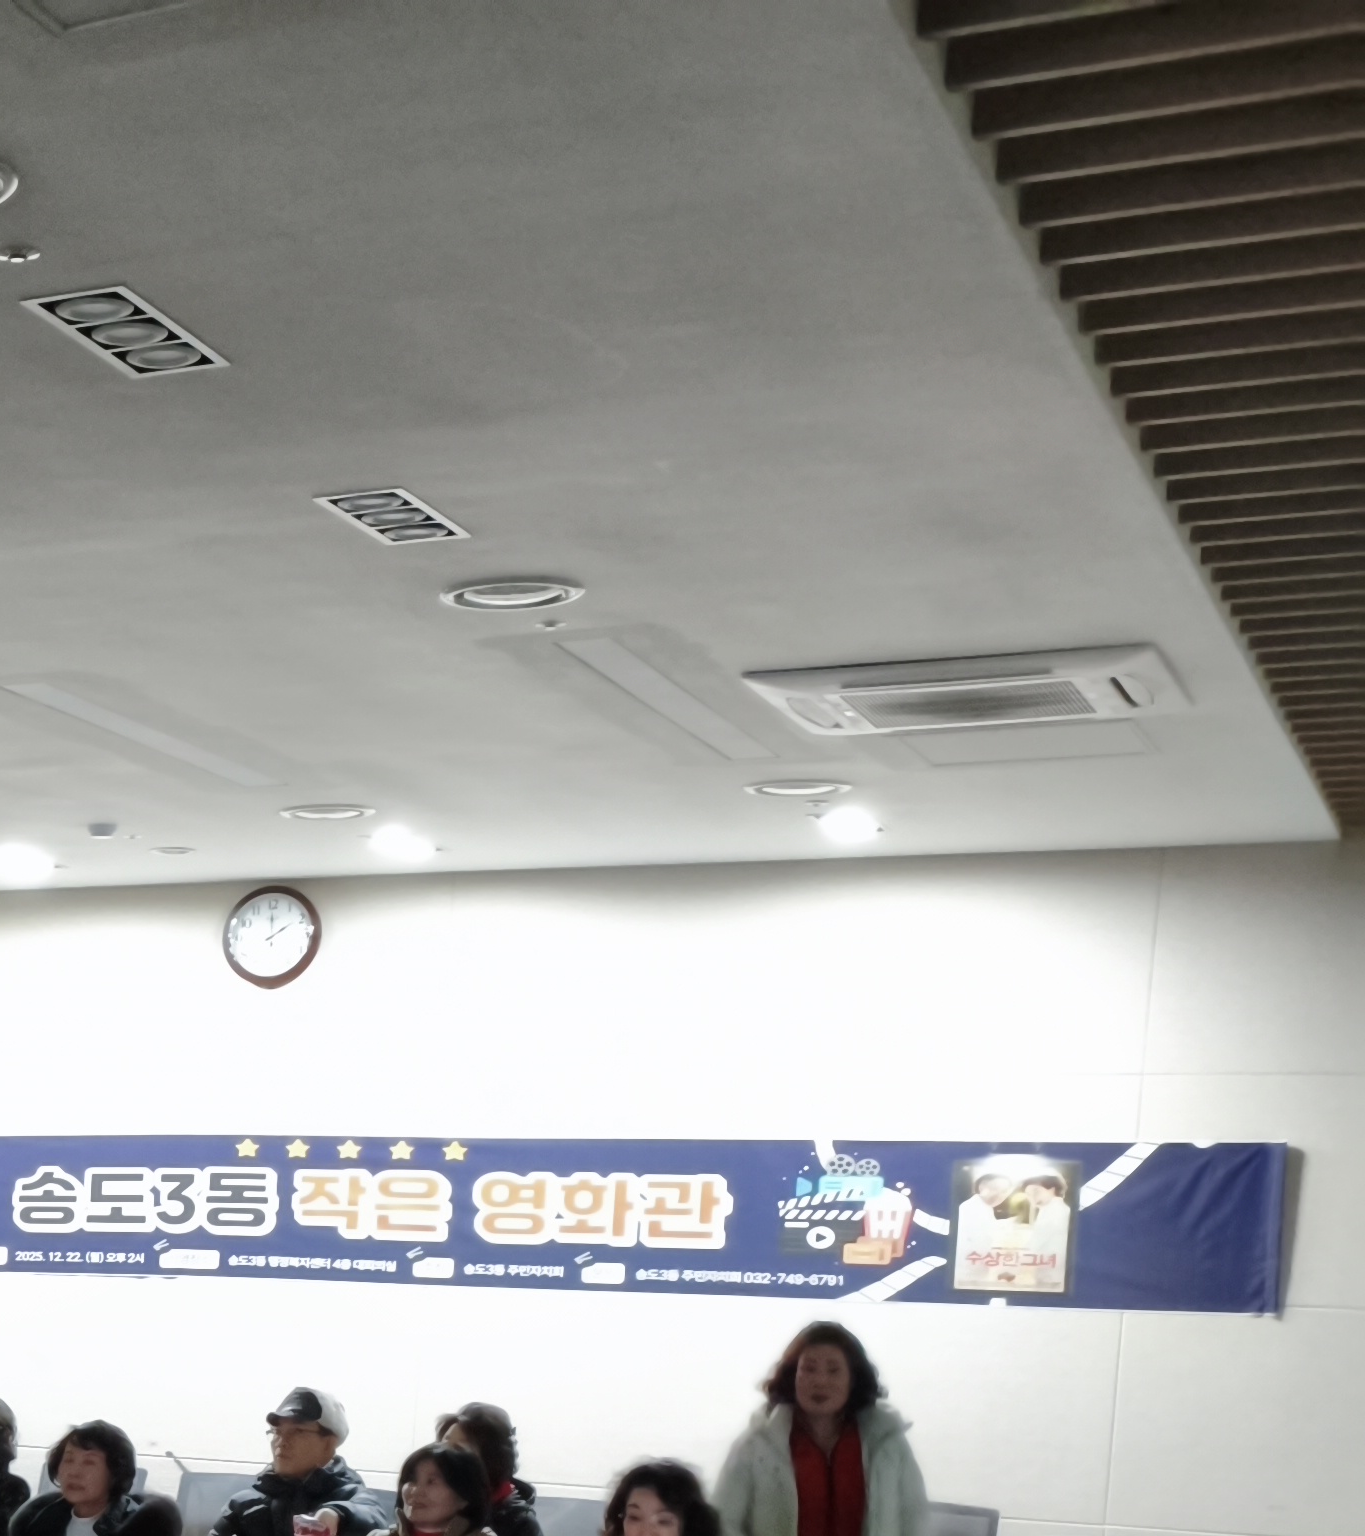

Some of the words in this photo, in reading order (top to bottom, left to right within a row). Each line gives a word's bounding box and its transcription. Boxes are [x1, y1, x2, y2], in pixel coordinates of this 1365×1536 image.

[18, 1171, 269, 1228] 송도3동
[299, 1175, 441, 1232] 작은
[480, 1178, 722, 1240] 영화관
[127, 1252, 145, 1264] 2시
[227, 1254, 266, 1267] 송도3동
[965, 1250, 1018, 1267] 수상한
[1020, 1252, 1057, 1268] 그녀
[463, 1263, 506, 1277] 송도3동
[635, 1268, 680, 1282] 송도3동
